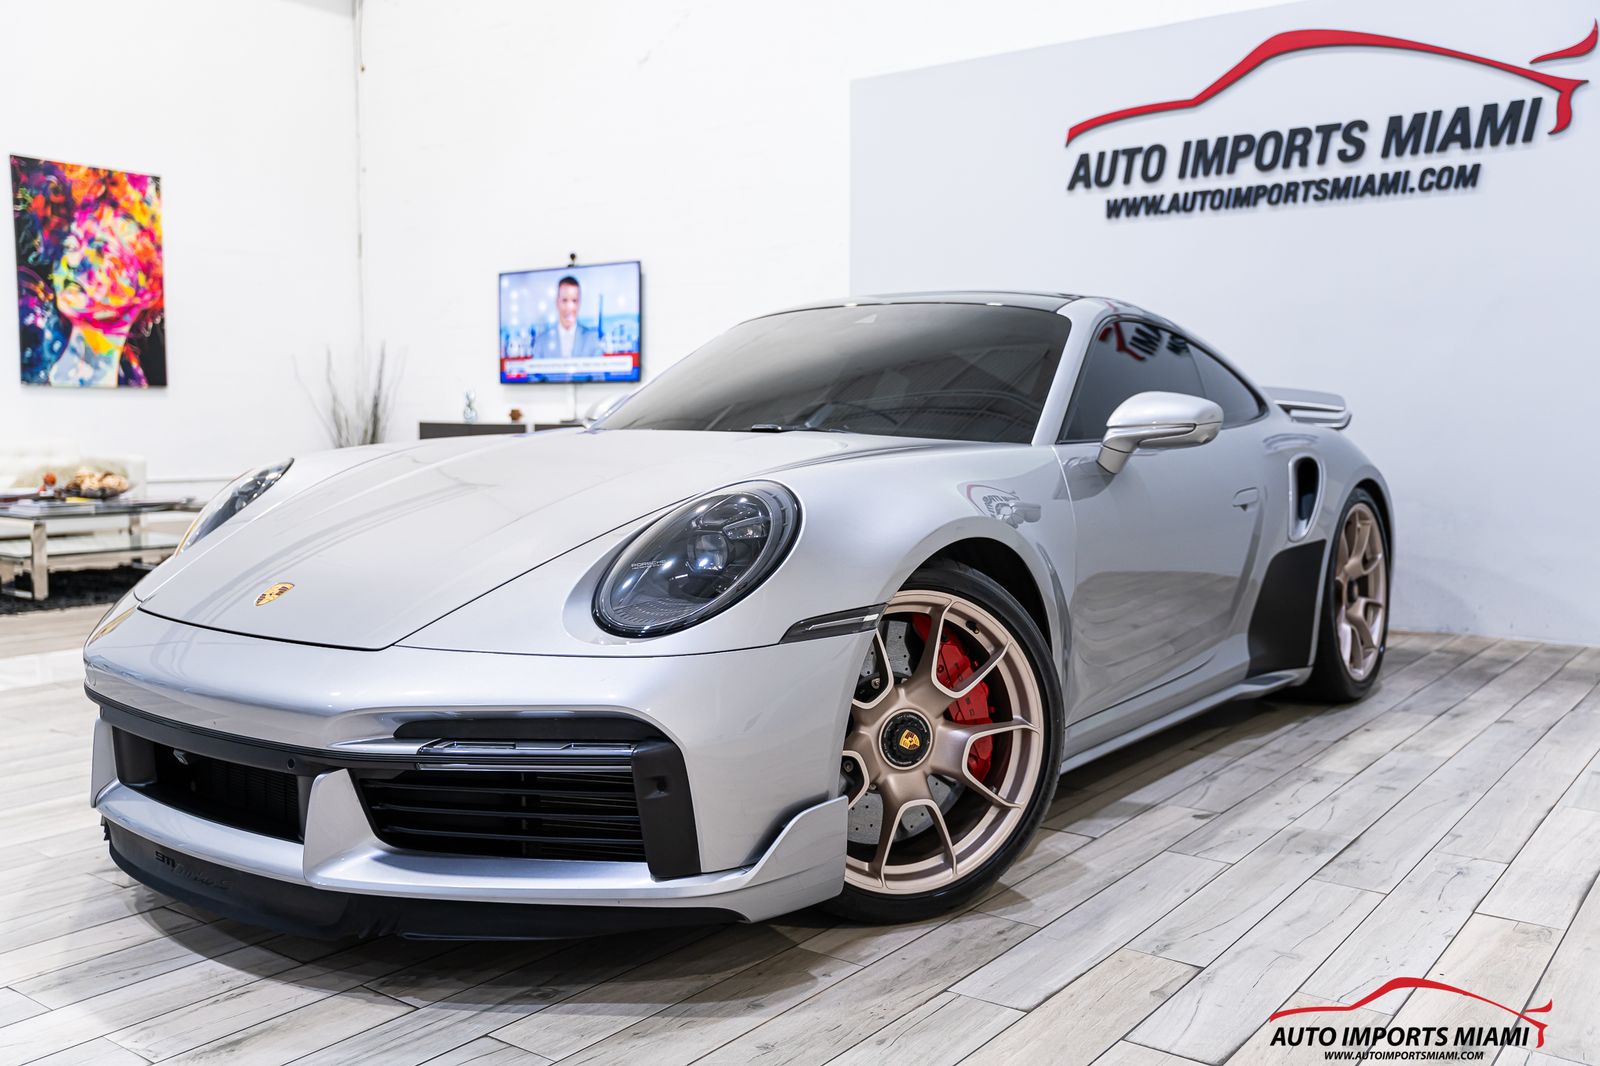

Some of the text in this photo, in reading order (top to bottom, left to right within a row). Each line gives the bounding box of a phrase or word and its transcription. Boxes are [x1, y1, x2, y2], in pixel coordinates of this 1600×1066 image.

[1067, 97, 1542, 190] AUTO IMPORTS MIAMI
[1105, 163, 1481, 219] WWW.AUTOIMPORTSMIAMI.COM
